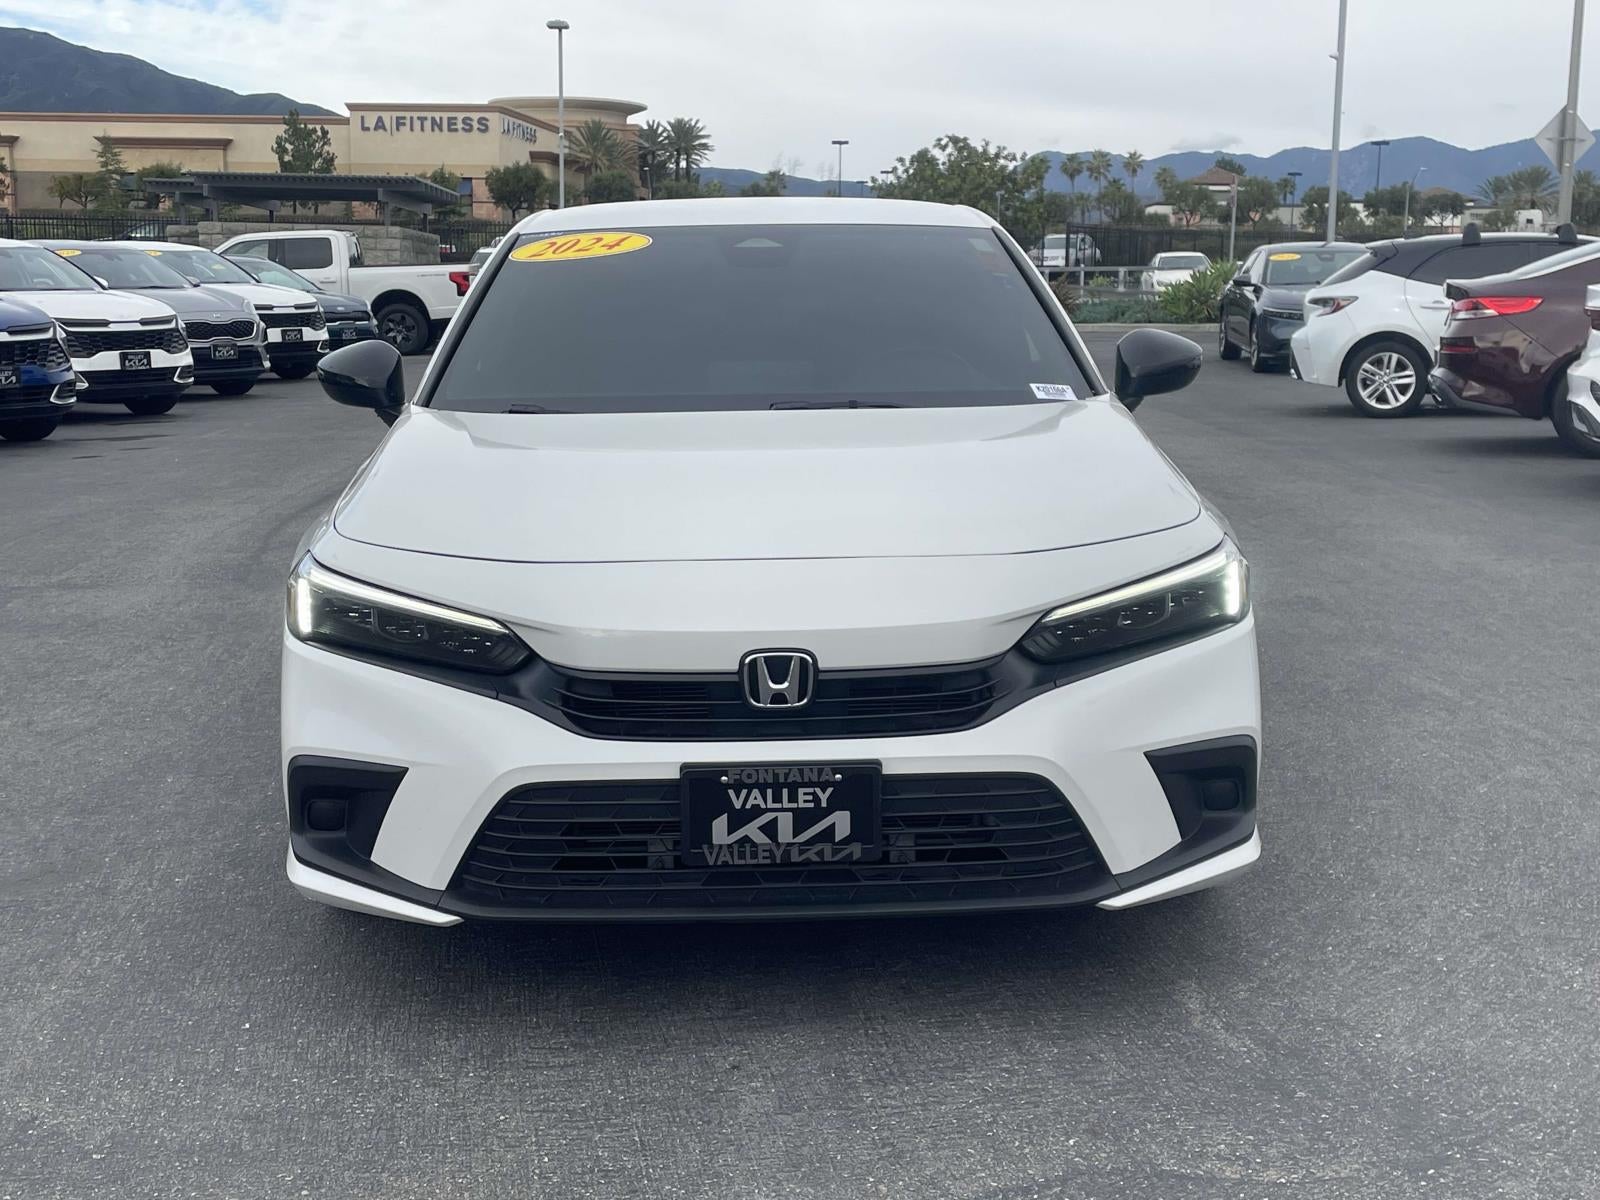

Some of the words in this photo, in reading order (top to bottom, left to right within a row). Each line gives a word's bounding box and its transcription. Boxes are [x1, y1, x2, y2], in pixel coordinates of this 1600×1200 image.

[527, 236, 632, 258] 2024
[727, 767, 834, 784] FONTANA
[728, 787, 833, 809] VALLEY
[712, 811, 851, 845] KIA
[702, 844, 786, 866] VALLEY
[789, 842, 862, 862] KIA
